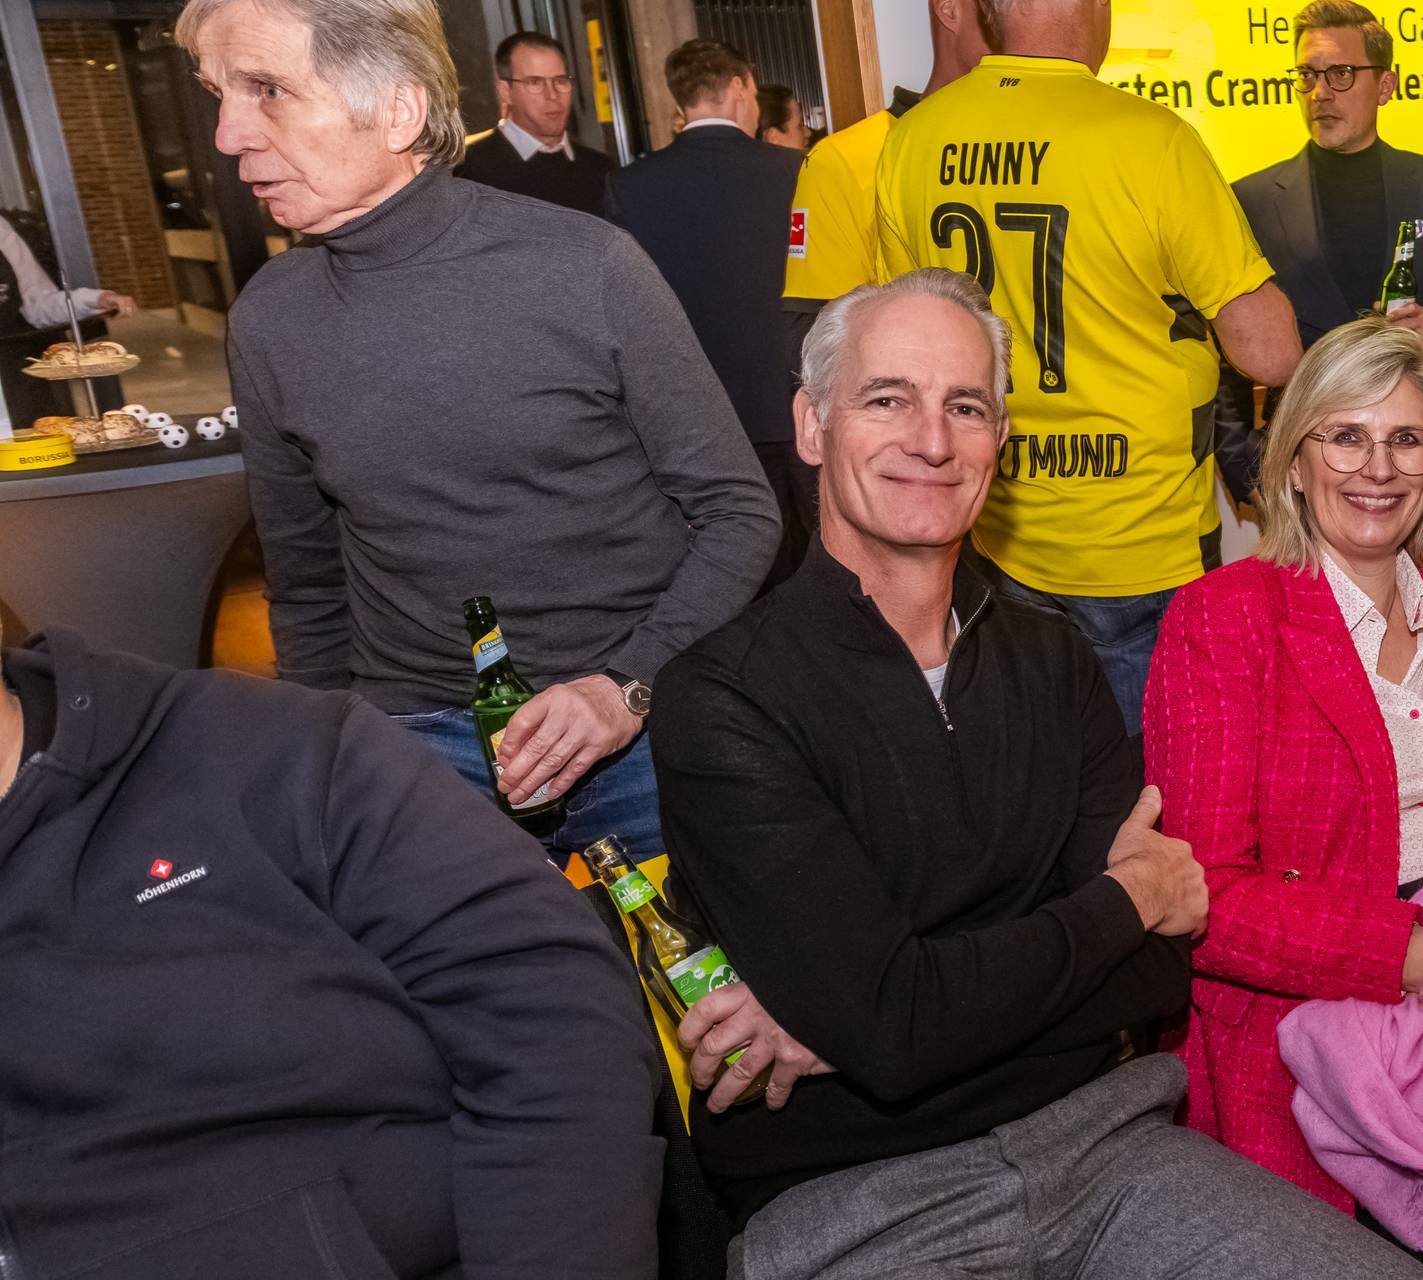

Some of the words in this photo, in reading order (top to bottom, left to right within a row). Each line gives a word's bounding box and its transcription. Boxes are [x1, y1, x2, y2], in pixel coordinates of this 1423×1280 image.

[1206, 70, 1293, 107] Cram
[940, 141, 1050, 186] GUNNY
[19, 451, 70, 464] BORUSSIA
[997, 433, 1128, 478] TMUND
[136, 866, 207, 903] HÖHENHORN
